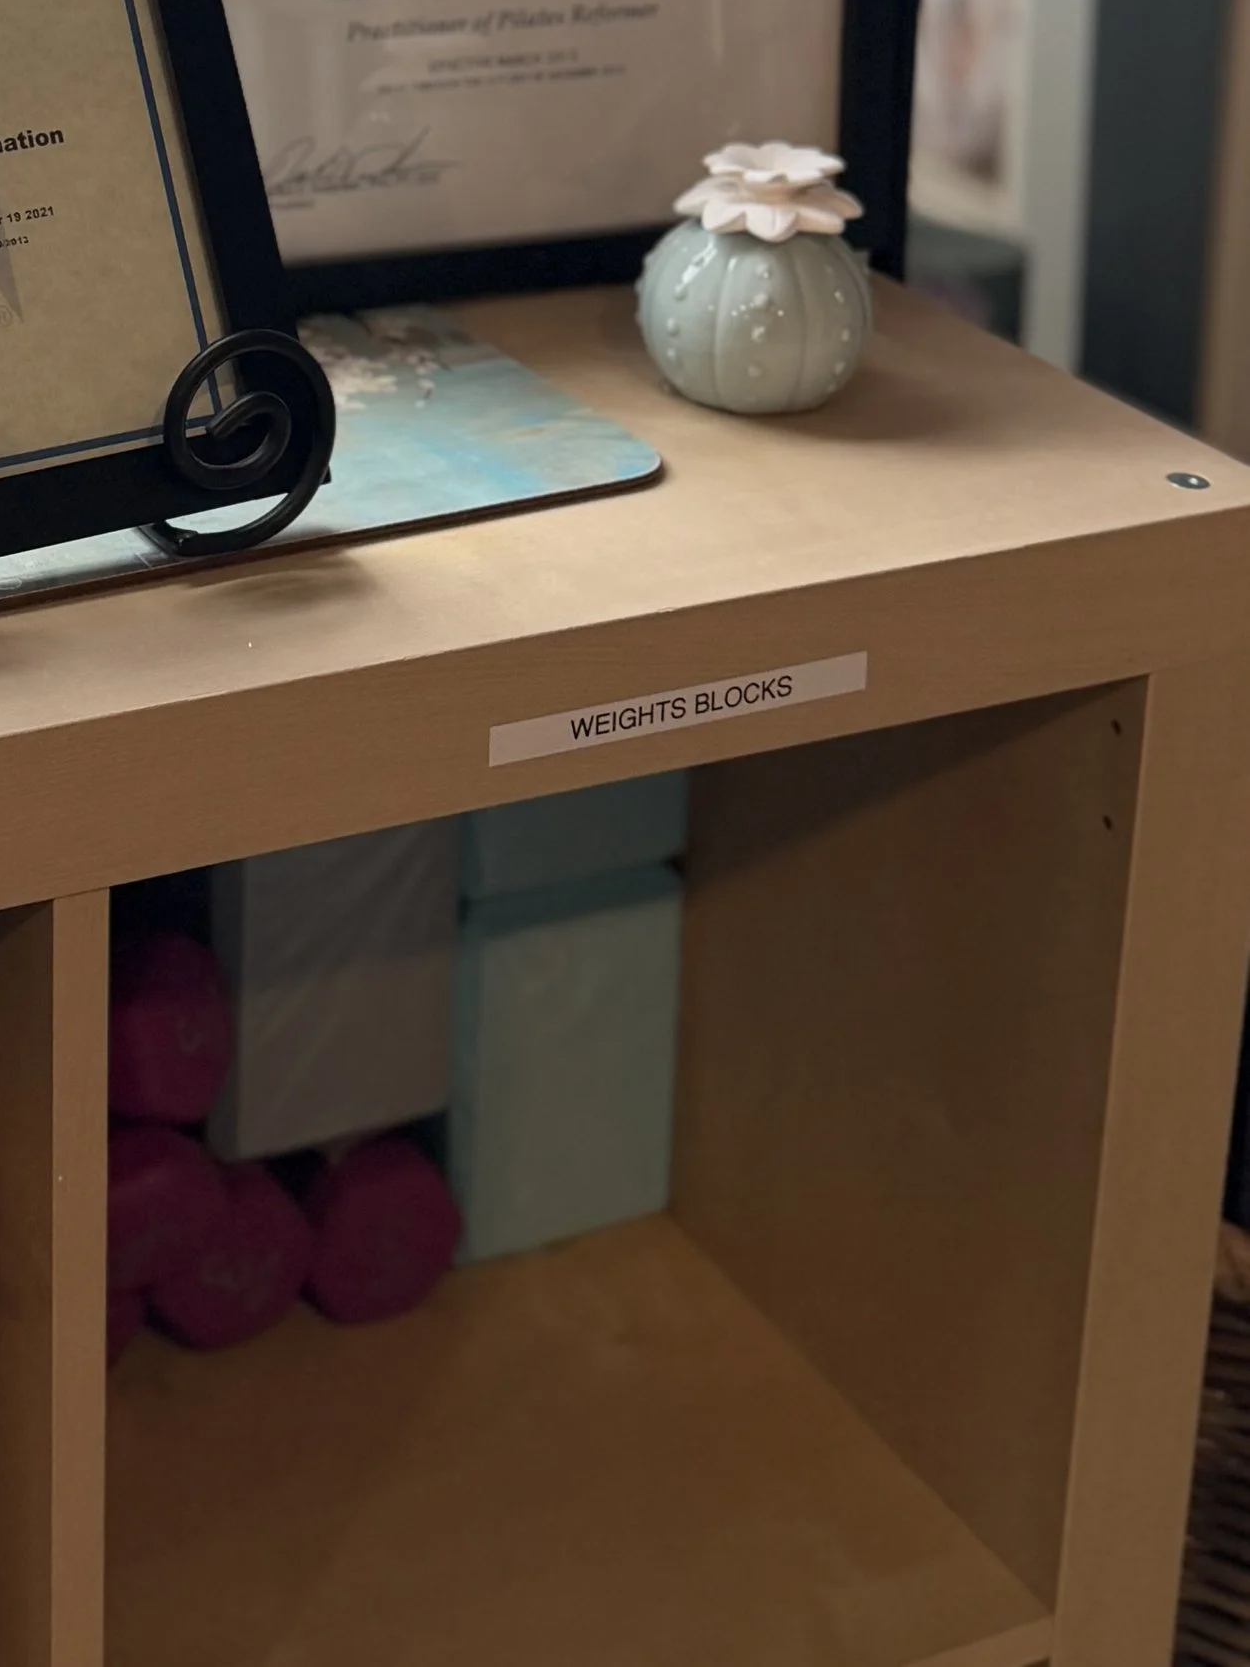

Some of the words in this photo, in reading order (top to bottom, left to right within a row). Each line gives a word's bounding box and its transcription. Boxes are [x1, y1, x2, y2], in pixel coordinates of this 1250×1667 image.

[6, 210, 21, 223] 19
[25, 205, 55, 220] 2021
[570, 697, 686, 740] WEIGHTS
[695, 675, 793, 714] BLOCKS
